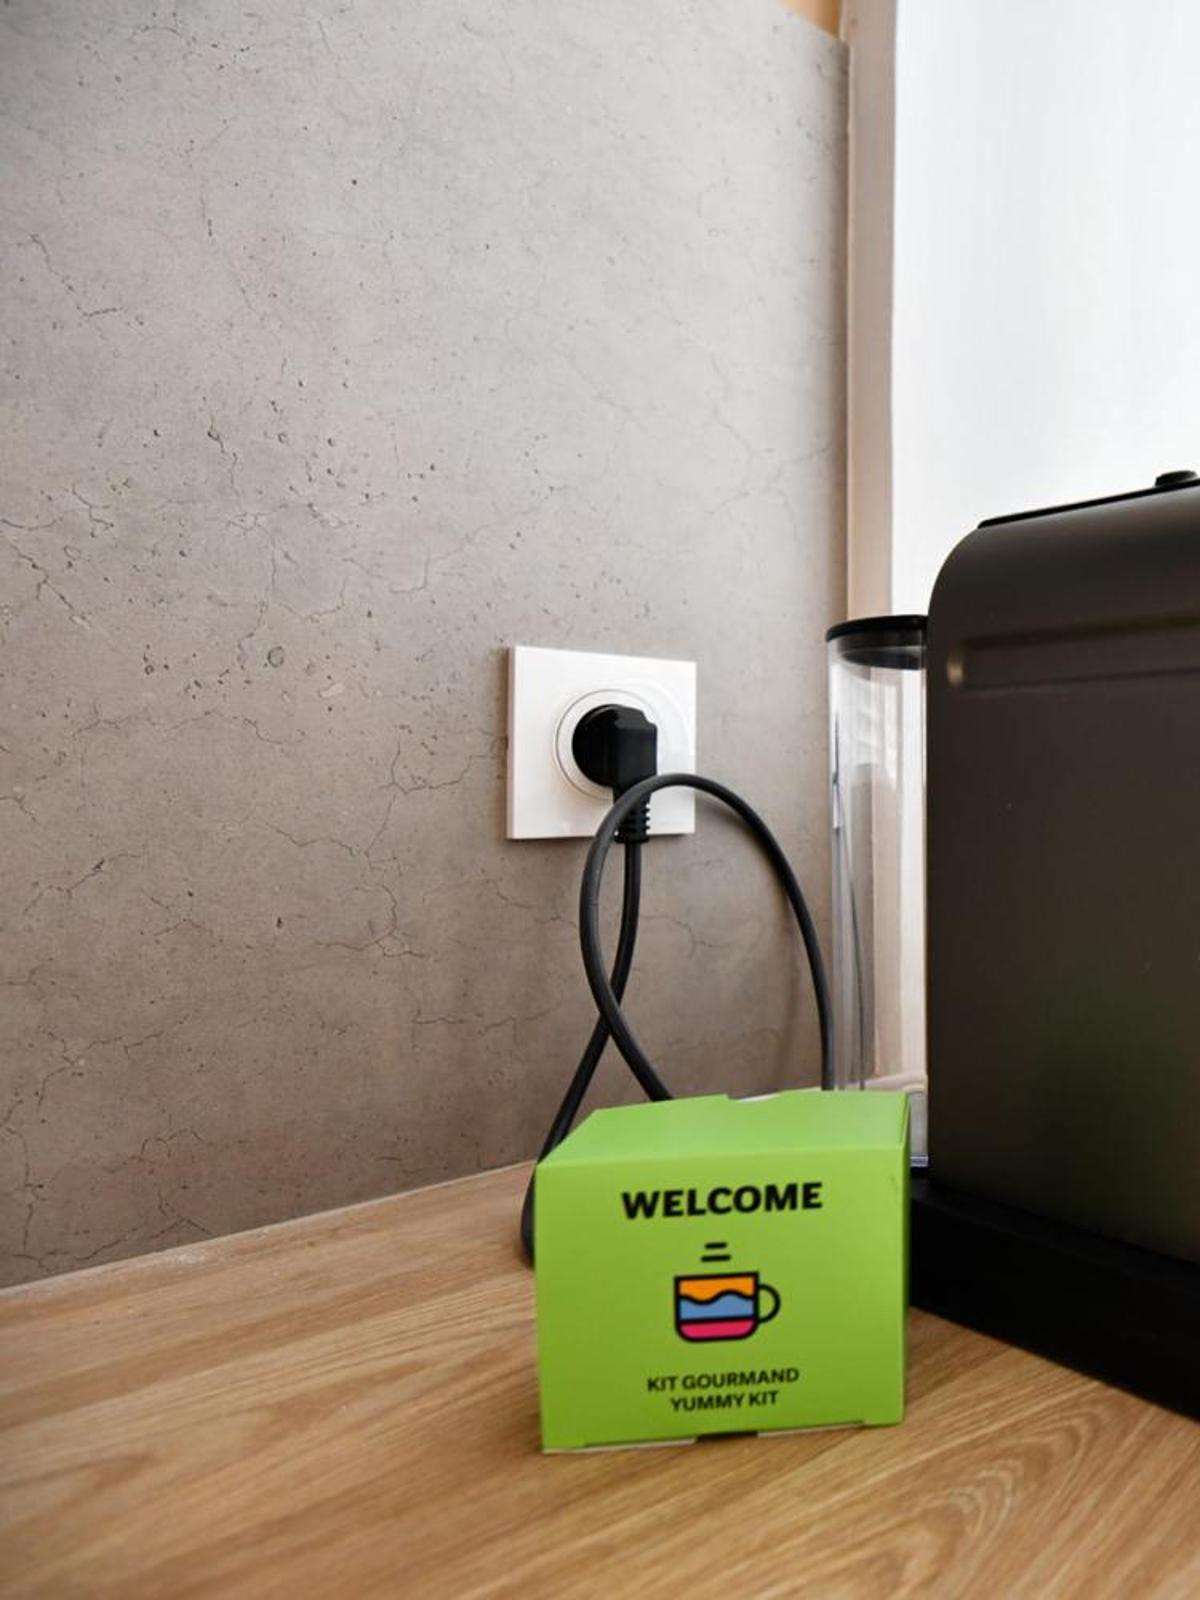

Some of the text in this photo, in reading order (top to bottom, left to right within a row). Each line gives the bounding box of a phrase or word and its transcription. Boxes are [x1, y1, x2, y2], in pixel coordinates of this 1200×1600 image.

[621, 1181, 823, 1220] WELCOME
[646, 1367, 800, 1392] KIT GOURMAND
[670, 1389, 780, 1412] YUMMY KIT
